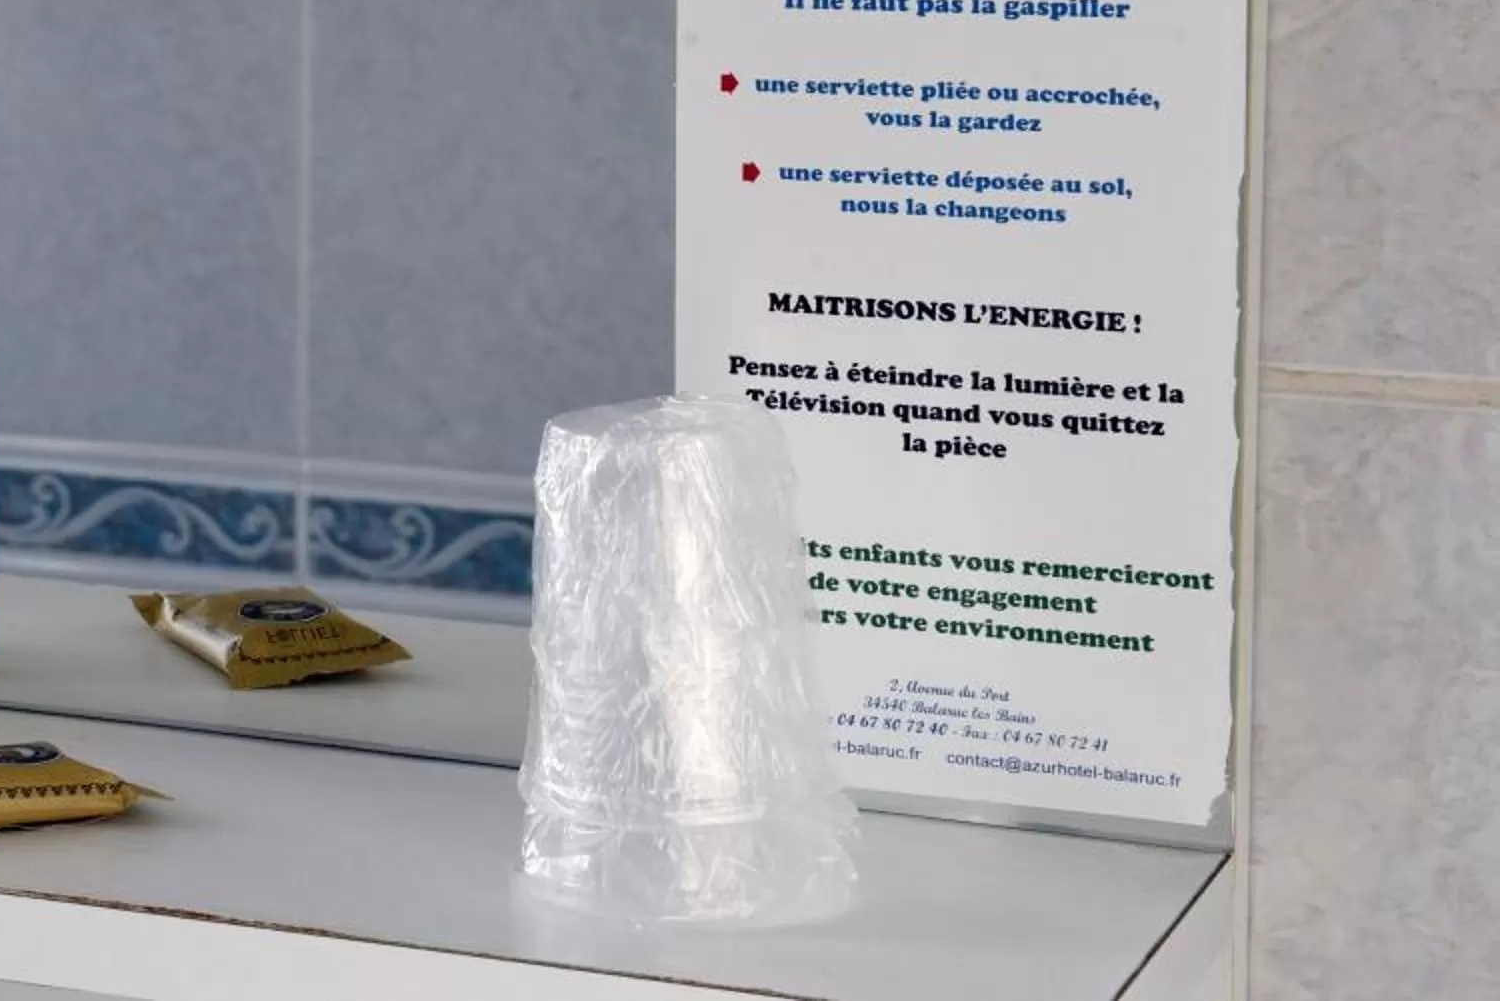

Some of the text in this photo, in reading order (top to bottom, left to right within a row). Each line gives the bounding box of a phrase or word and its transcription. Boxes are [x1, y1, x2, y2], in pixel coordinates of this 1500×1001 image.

[755, 78, 1161, 111] une serviette pliée ou accrochée,
[865, 110, 1042, 134] vous la gardez
[778, 166, 1133, 200] une serviette déposée au sol,
[840, 198, 1067, 224] nous la changeons
[768, 292, 957, 323] MAITRISONS
[963, 303, 1127, 333] L'ENERGIE
[728, 355, 1185, 404] Pensez à éteindre la lumière et la
[892, 403, 981, 424] quand
[987, 409, 1054, 429] vous
[1061, 412, 1165, 437] quittez
[902, 432, 1008, 459] la pièce
[838, 543, 943, 568] enfants
[949, 554, 1015, 574] vous
[1022, 560, 1215, 591] remercieront
[807, 571, 1097, 615] de votre engagement
[853, 611, 928, 632] votre
[934, 618, 1155, 653] environnement
[957, 684, 976, 700] du
[911, 700, 969, 719] Balaruc
[971, 706, 991, 720] les
[995, 709, 1037, 725] Bains
[946, 753, 1182, 788] contact@azurhotel-balaruc.fr
